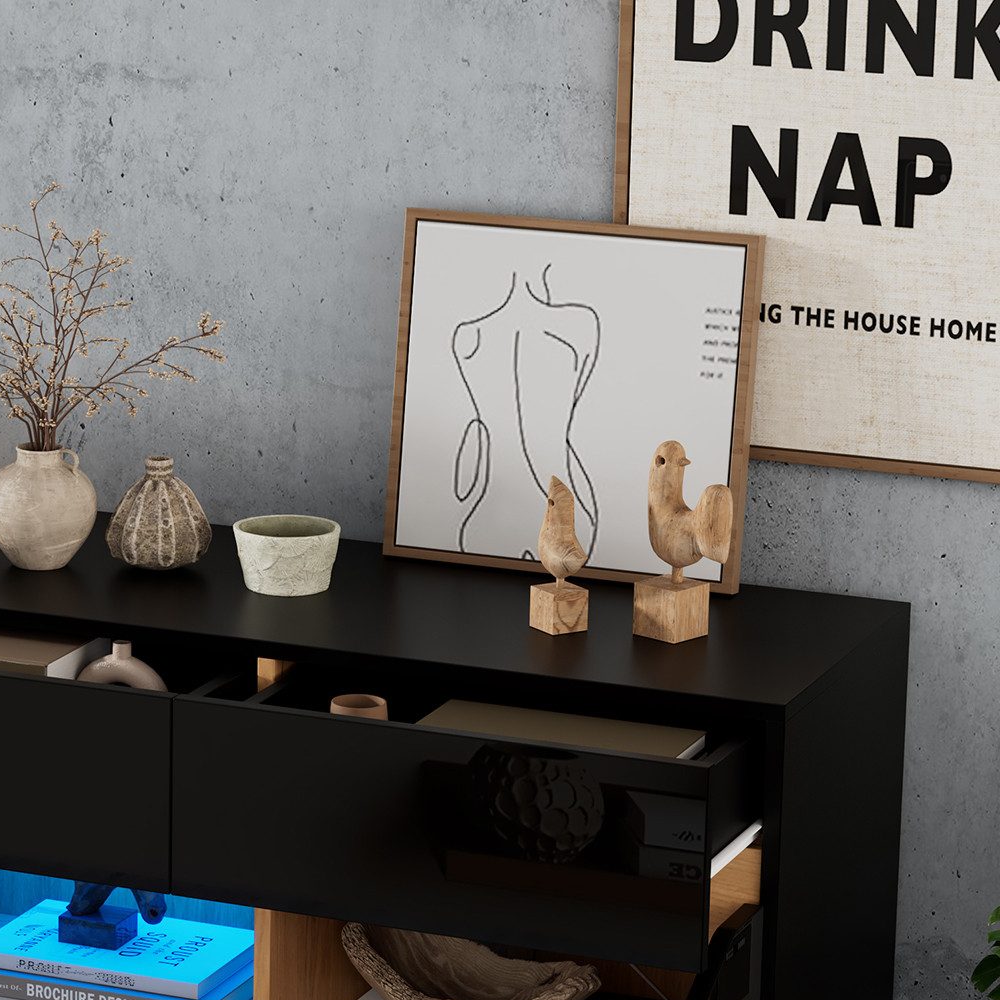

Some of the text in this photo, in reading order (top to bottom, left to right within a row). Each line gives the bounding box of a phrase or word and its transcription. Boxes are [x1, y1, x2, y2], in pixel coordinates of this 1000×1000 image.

[674, 0, 1000, 81] DRINK
[729, 125, 952, 228] NAP
[790, 306, 835, 328] THE
[843, 311, 921, 337] HOUSE
[930, 318, 997, 343] HOME
[119, 932, 167, 957] SQUID
[158, 936, 213, 967] PROUST
